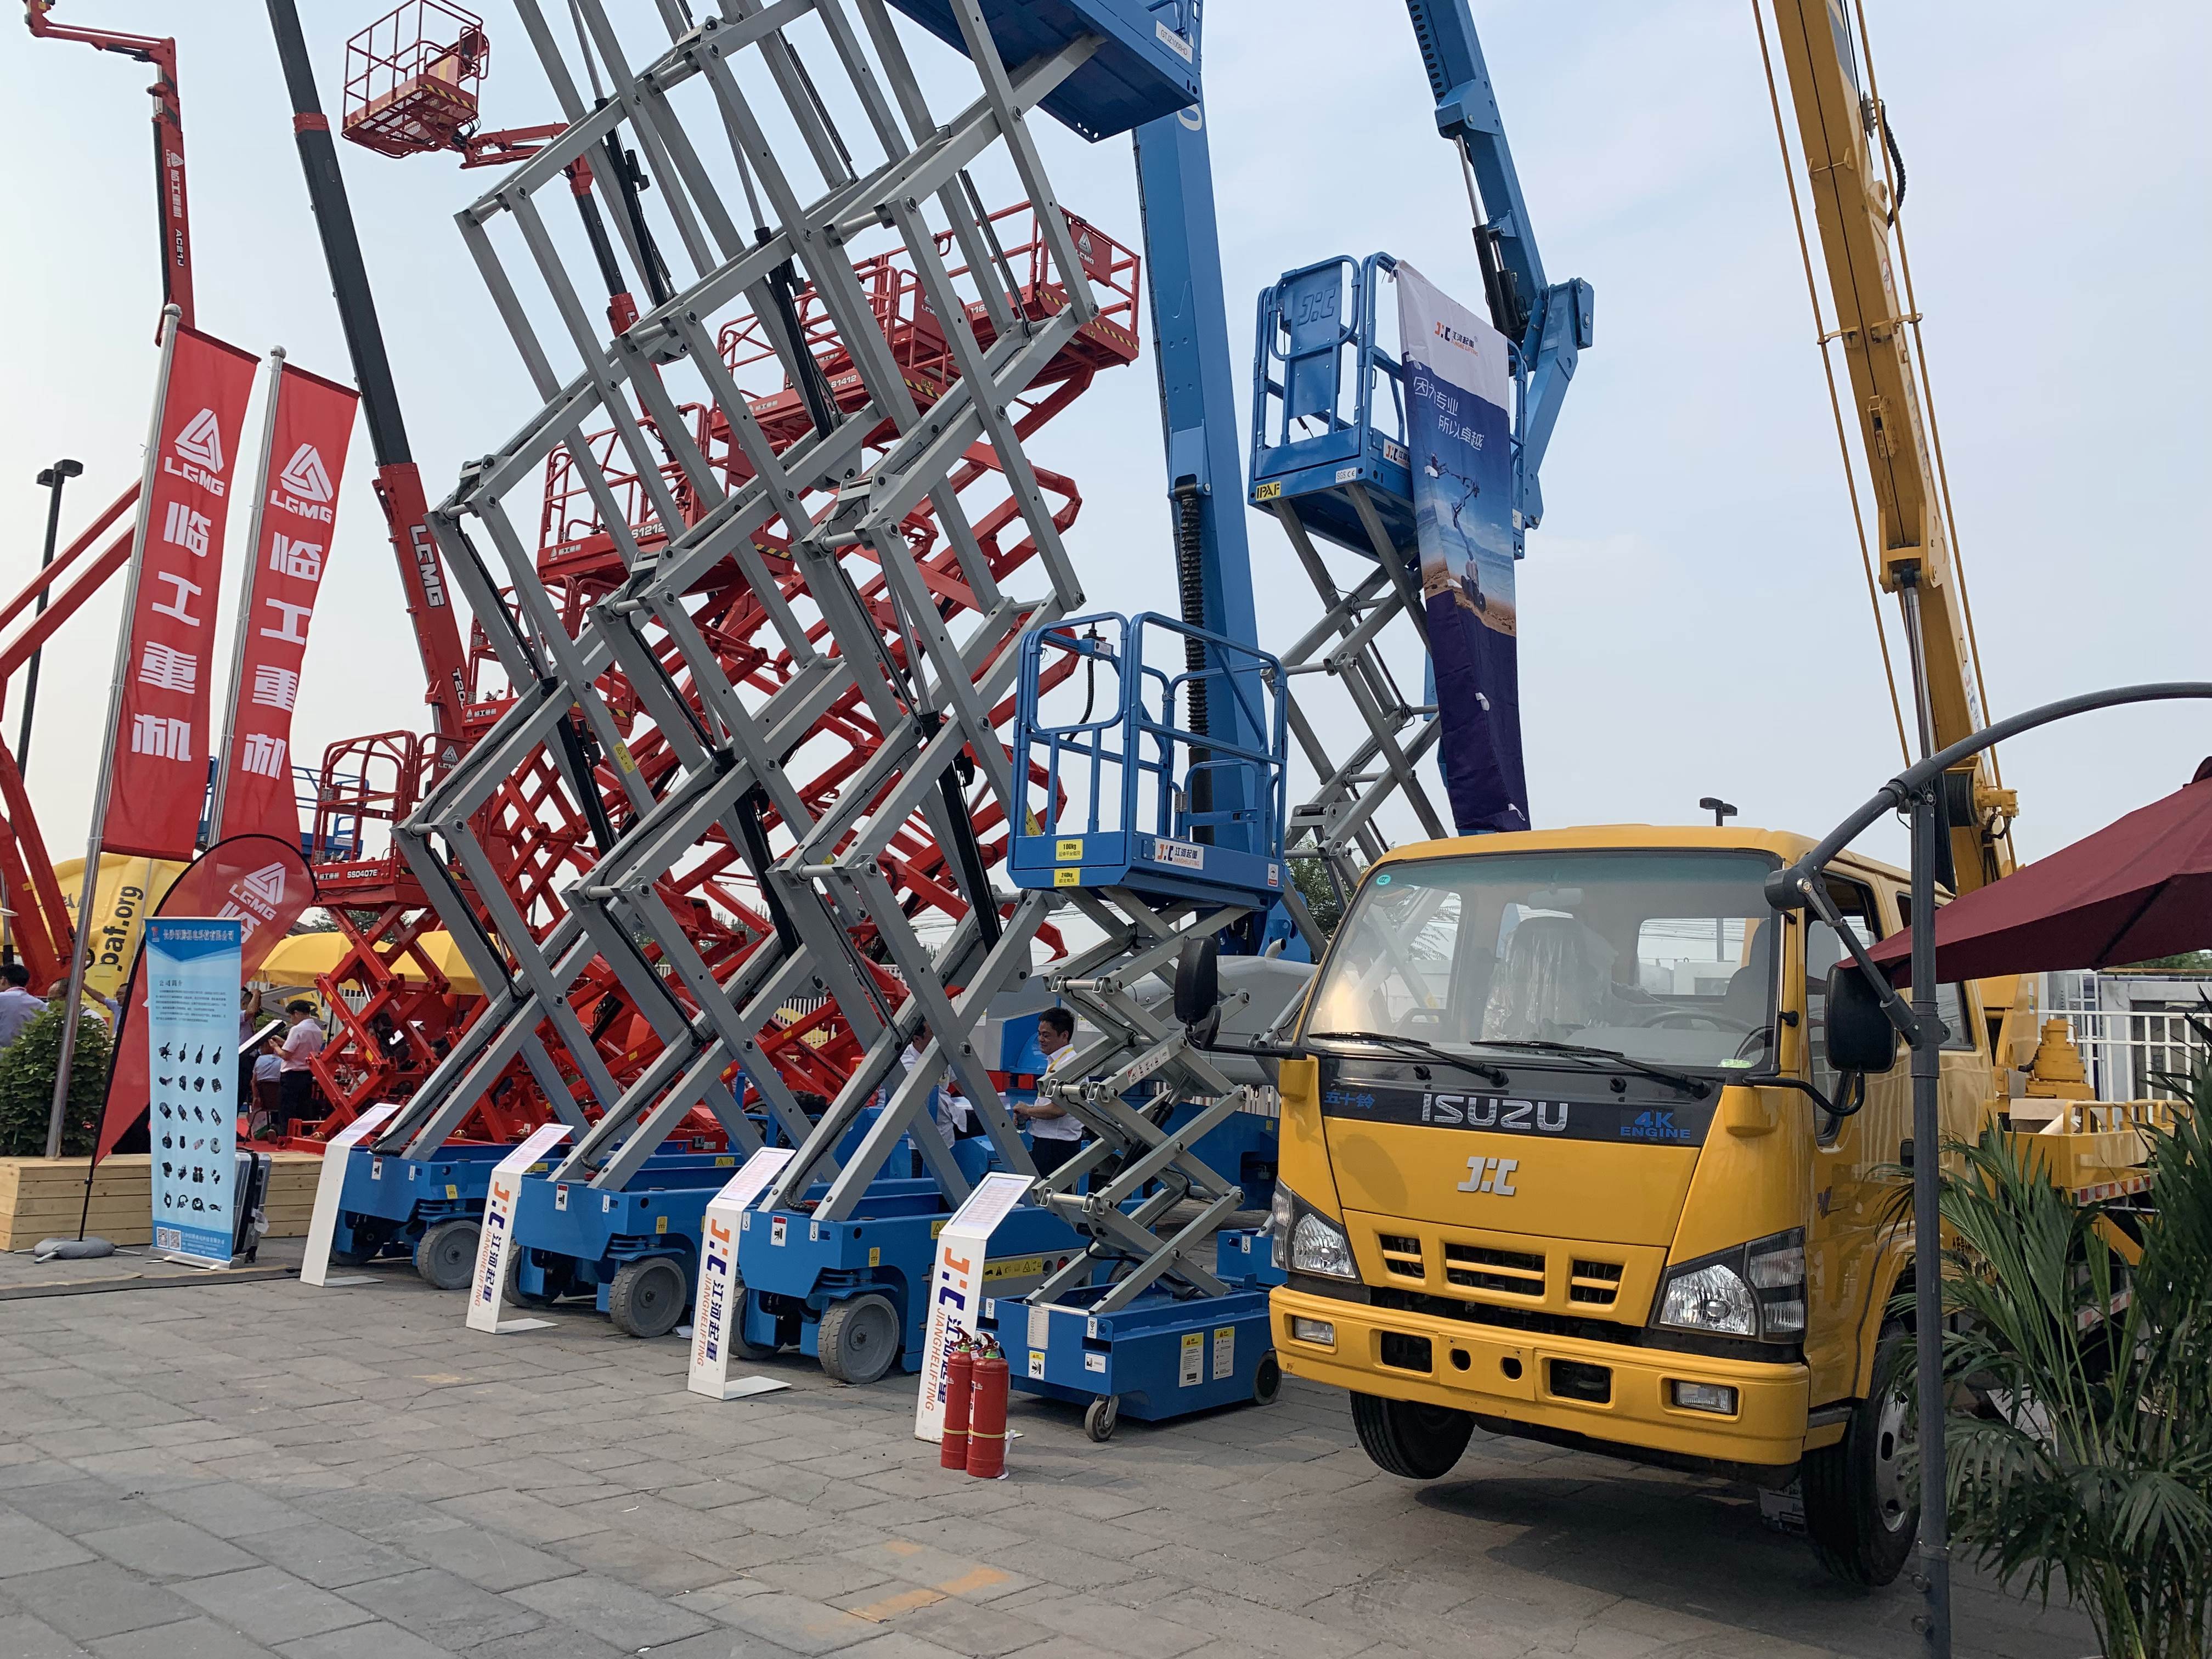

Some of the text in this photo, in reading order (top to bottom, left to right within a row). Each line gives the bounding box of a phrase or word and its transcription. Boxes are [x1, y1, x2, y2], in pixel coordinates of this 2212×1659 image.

[921, 304, 936, 316] LGM
[1438, 414, 1485, 451] 所以卓越
[164, 456, 225, 496] LGMG
[1256, 483, 1280, 499] IPAF
[1336, 472, 1346, 481] SGS
[269, 489, 333, 524] LGMG
[410, 524, 445, 607] LGMG
[131, 501, 212, 762] 临工重机
[241, 531, 324, 781] 临工重机
[1175, 846, 1198, 860] 江河起重
[228, 883, 278, 921] LGMG
[100, 886, 144, 972] paf.org
[1324, 1091, 1376, 1109] 五十铃
[1421, 1093, 1568, 1132] ISUZU
[1634, 1111, 1674, 1128] 4K
[1620, 1126, 1691, 1138] ENGINE
[474, 1228, 493, 1308] JIANGHELIFTING
[482, 1233, 502, 1304] 江河起重
[696, 1273, 712, 1367] JIANGHELIFTING
[706, 1279, 724, 1362] 江河起重
[925, 1307, 946, 1412] JIANGHELIFTING
